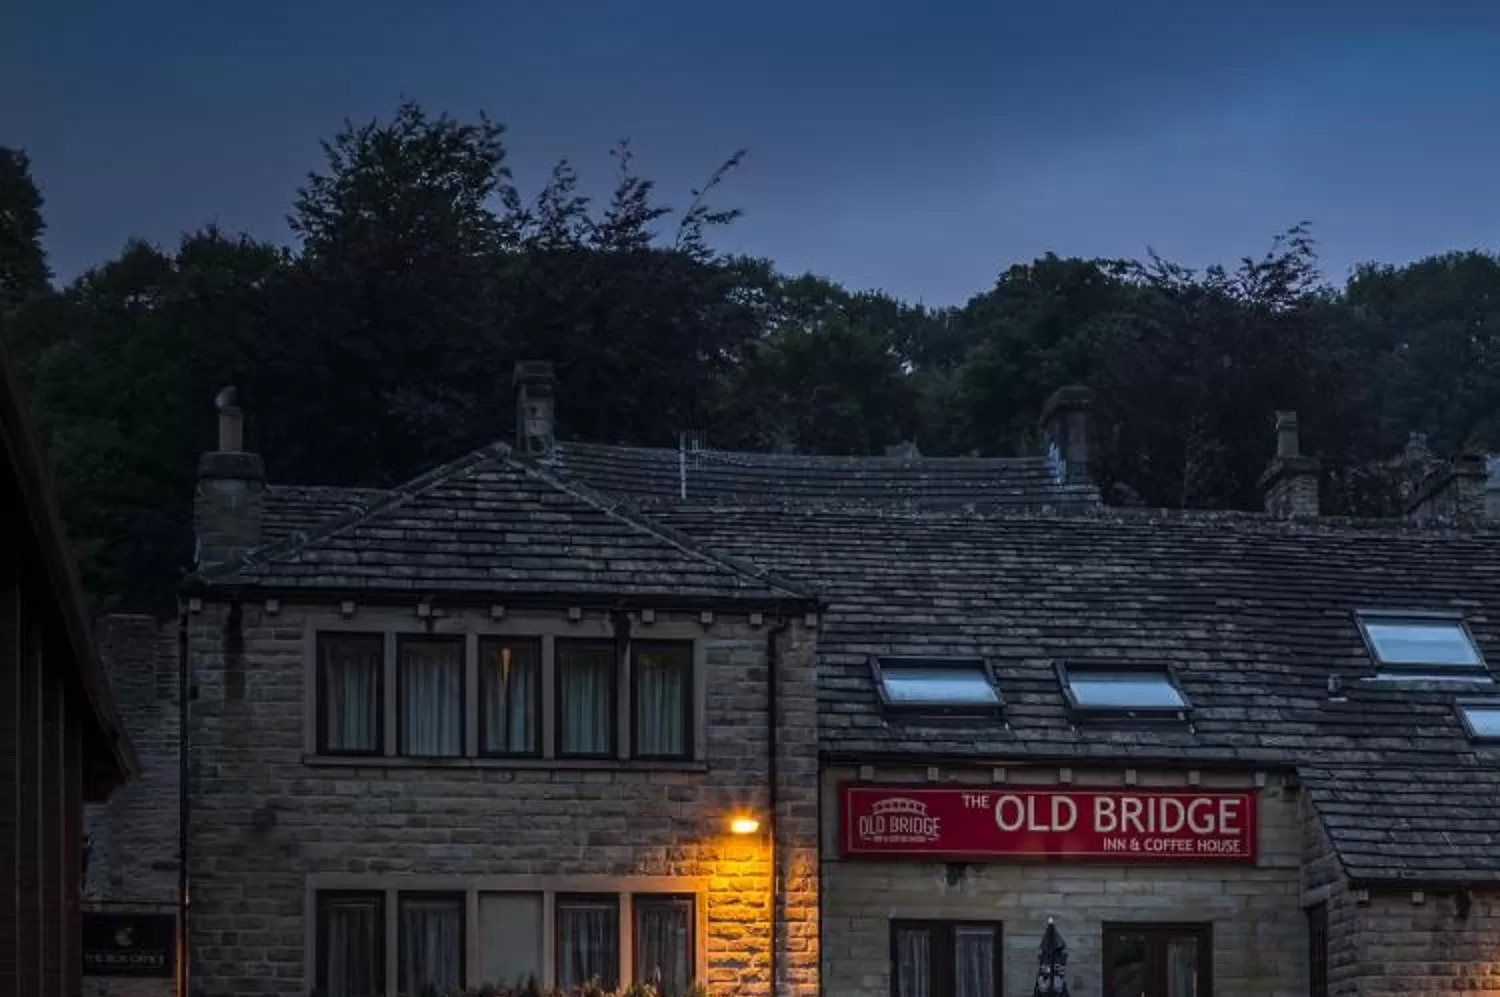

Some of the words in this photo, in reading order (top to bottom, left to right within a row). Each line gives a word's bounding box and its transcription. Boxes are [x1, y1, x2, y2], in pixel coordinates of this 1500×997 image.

[962, 794, 991, 809] THE
[995, 795, 1078, 833] OLD
[1094, 797, 1241, 835] BRIDGE
[860, 816, 885, 837] OLD
[889, 816, 941, 837] BRIDGE
[1103, 837, 1127, 852] INN
[1130, 839, 1141, 851] &
[1144, 838, 1195, 852] COFFEE
[1198, 839, 1241, 853] HOUSE
